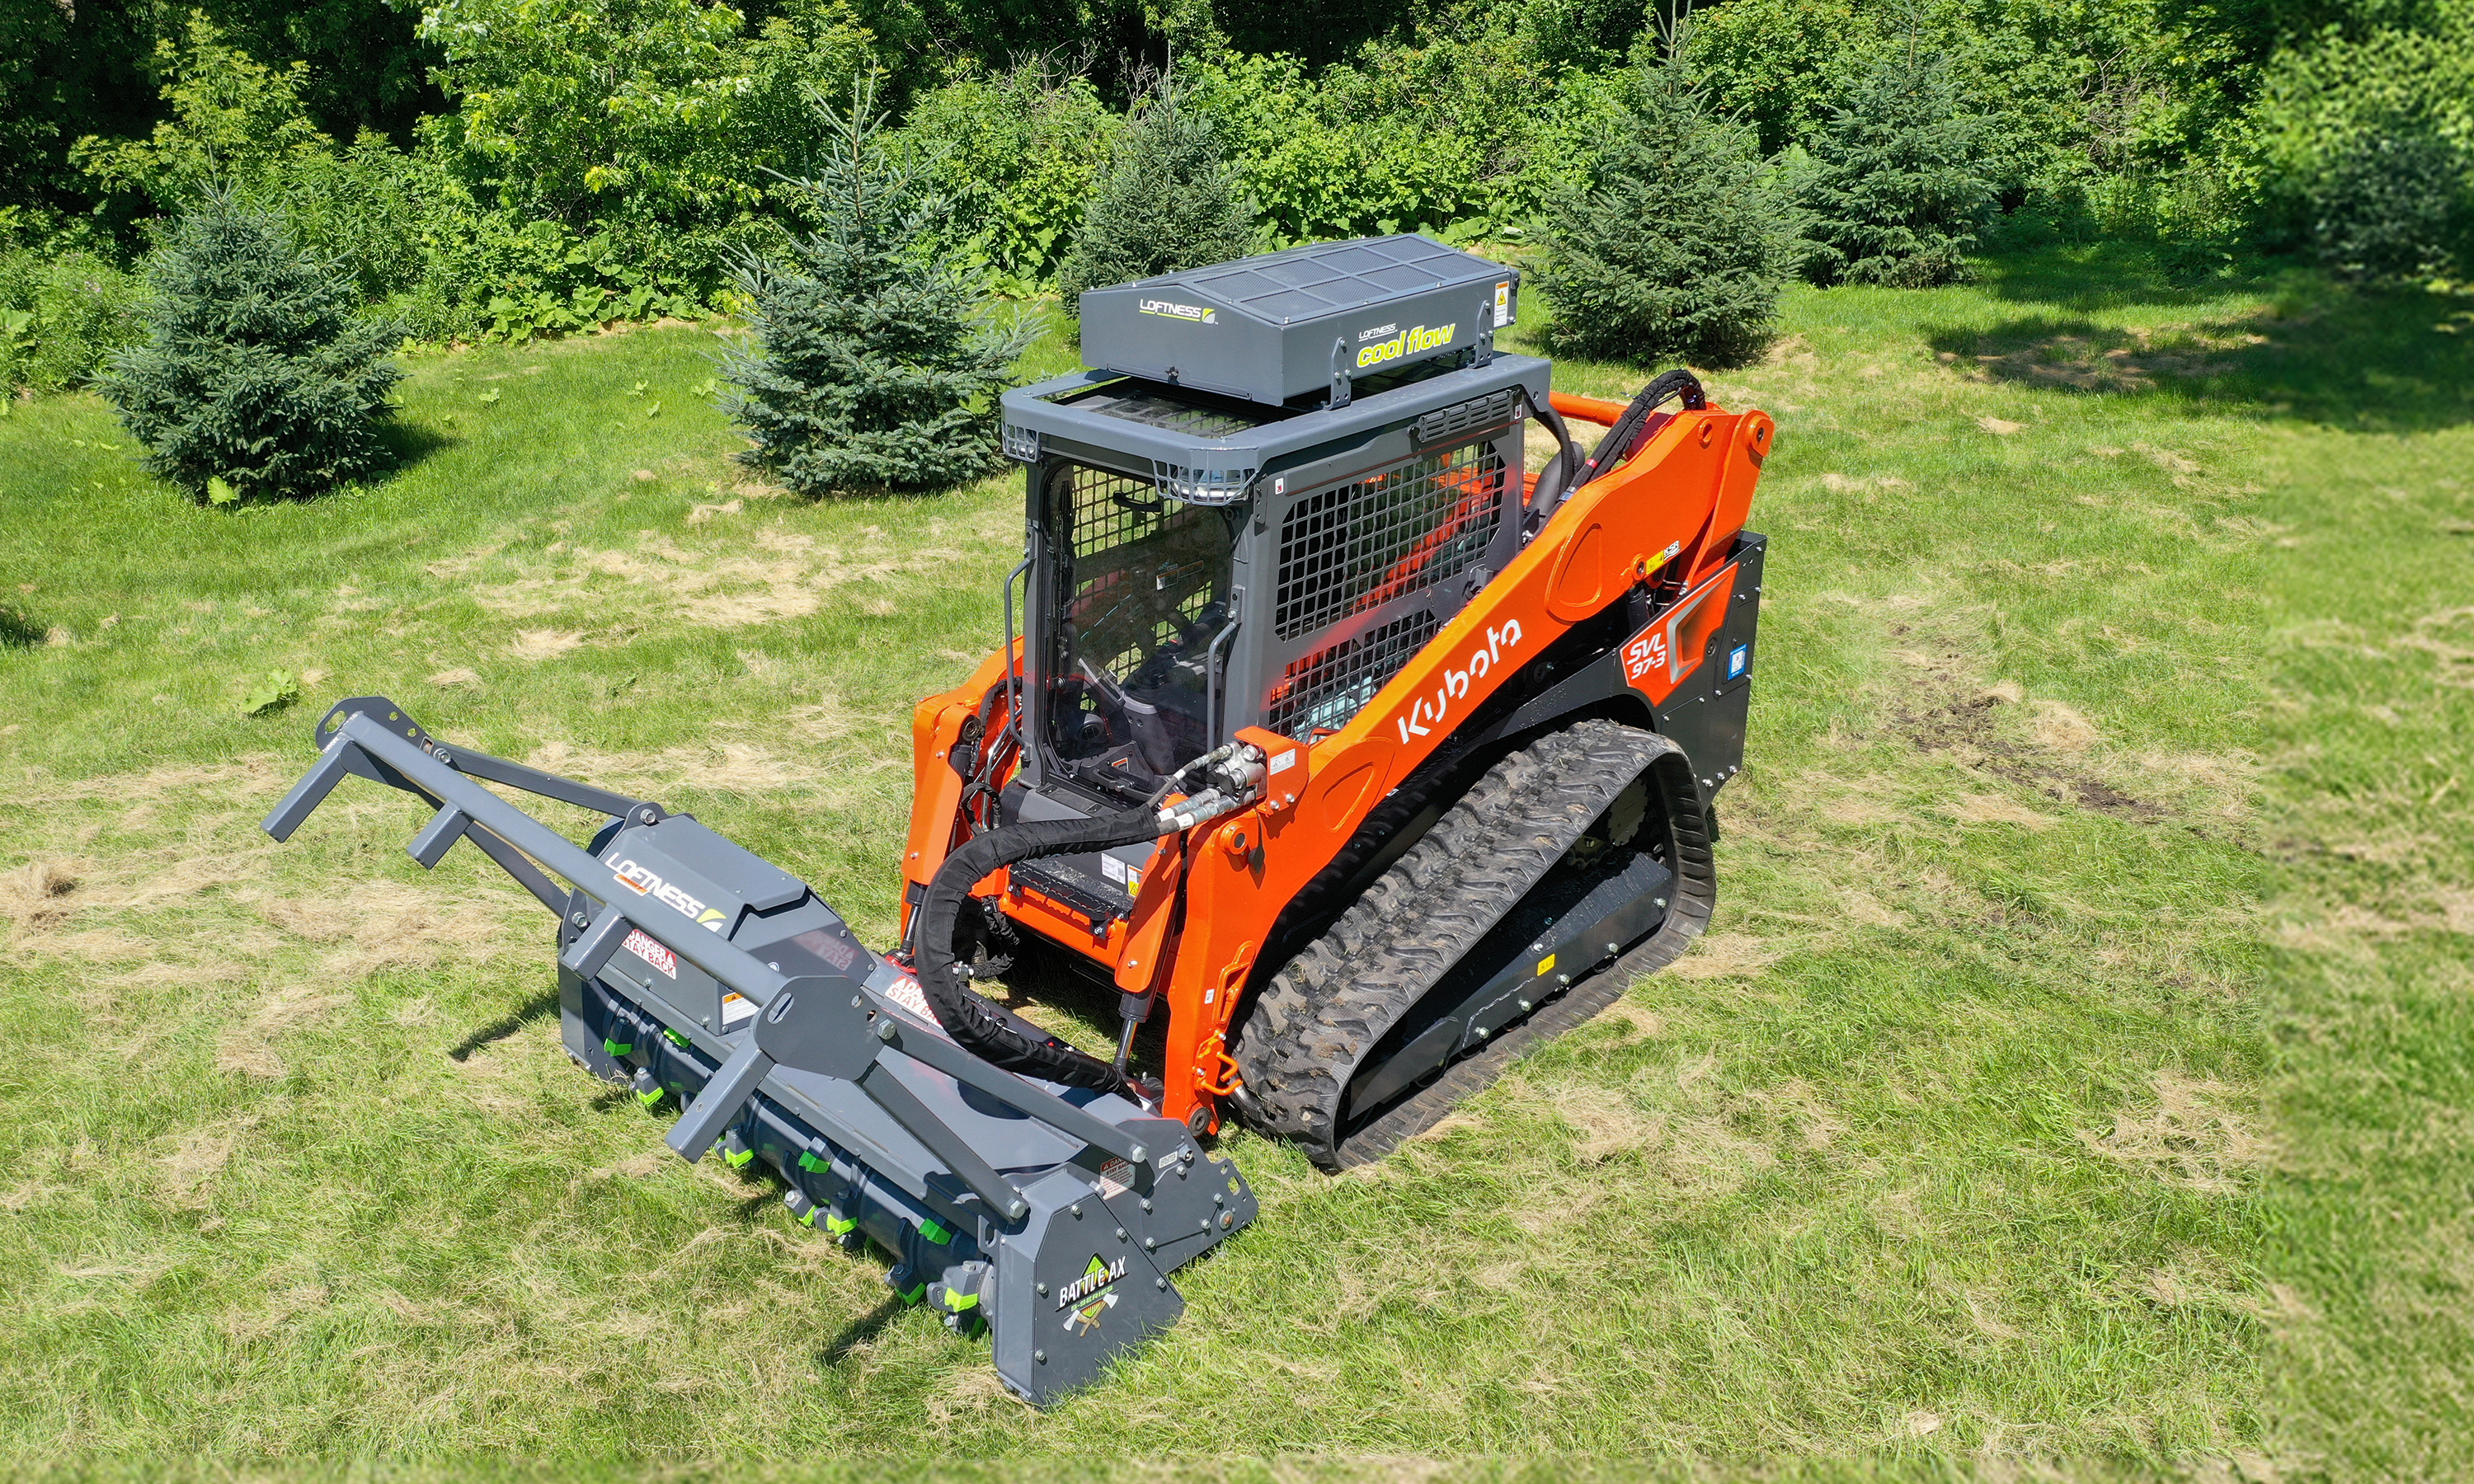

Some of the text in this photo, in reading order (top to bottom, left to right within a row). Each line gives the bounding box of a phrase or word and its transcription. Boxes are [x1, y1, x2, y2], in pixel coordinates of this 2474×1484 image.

[1140, 298, 1202, 318] LOFTNESS
[1357, 323, 1456, 368] cool flow
[1358, 322, 1396, 339] LOFTNESS
[1626, 632, 1666, 665] SVL
[1631, 650, 1667, 679] 97-3
[1397, 619, 1522, 744] Kubota
[604, 852, 706, 919] LOFTNESS
[628, 930, 666, 961] DANGER
[648, 951, 674, 977] BACK
[889, 987, 921, 1008] STAY
[920, 1006, 937, 1022] BA
[1059, 1256, 1126, 1308] BATTLE AX
